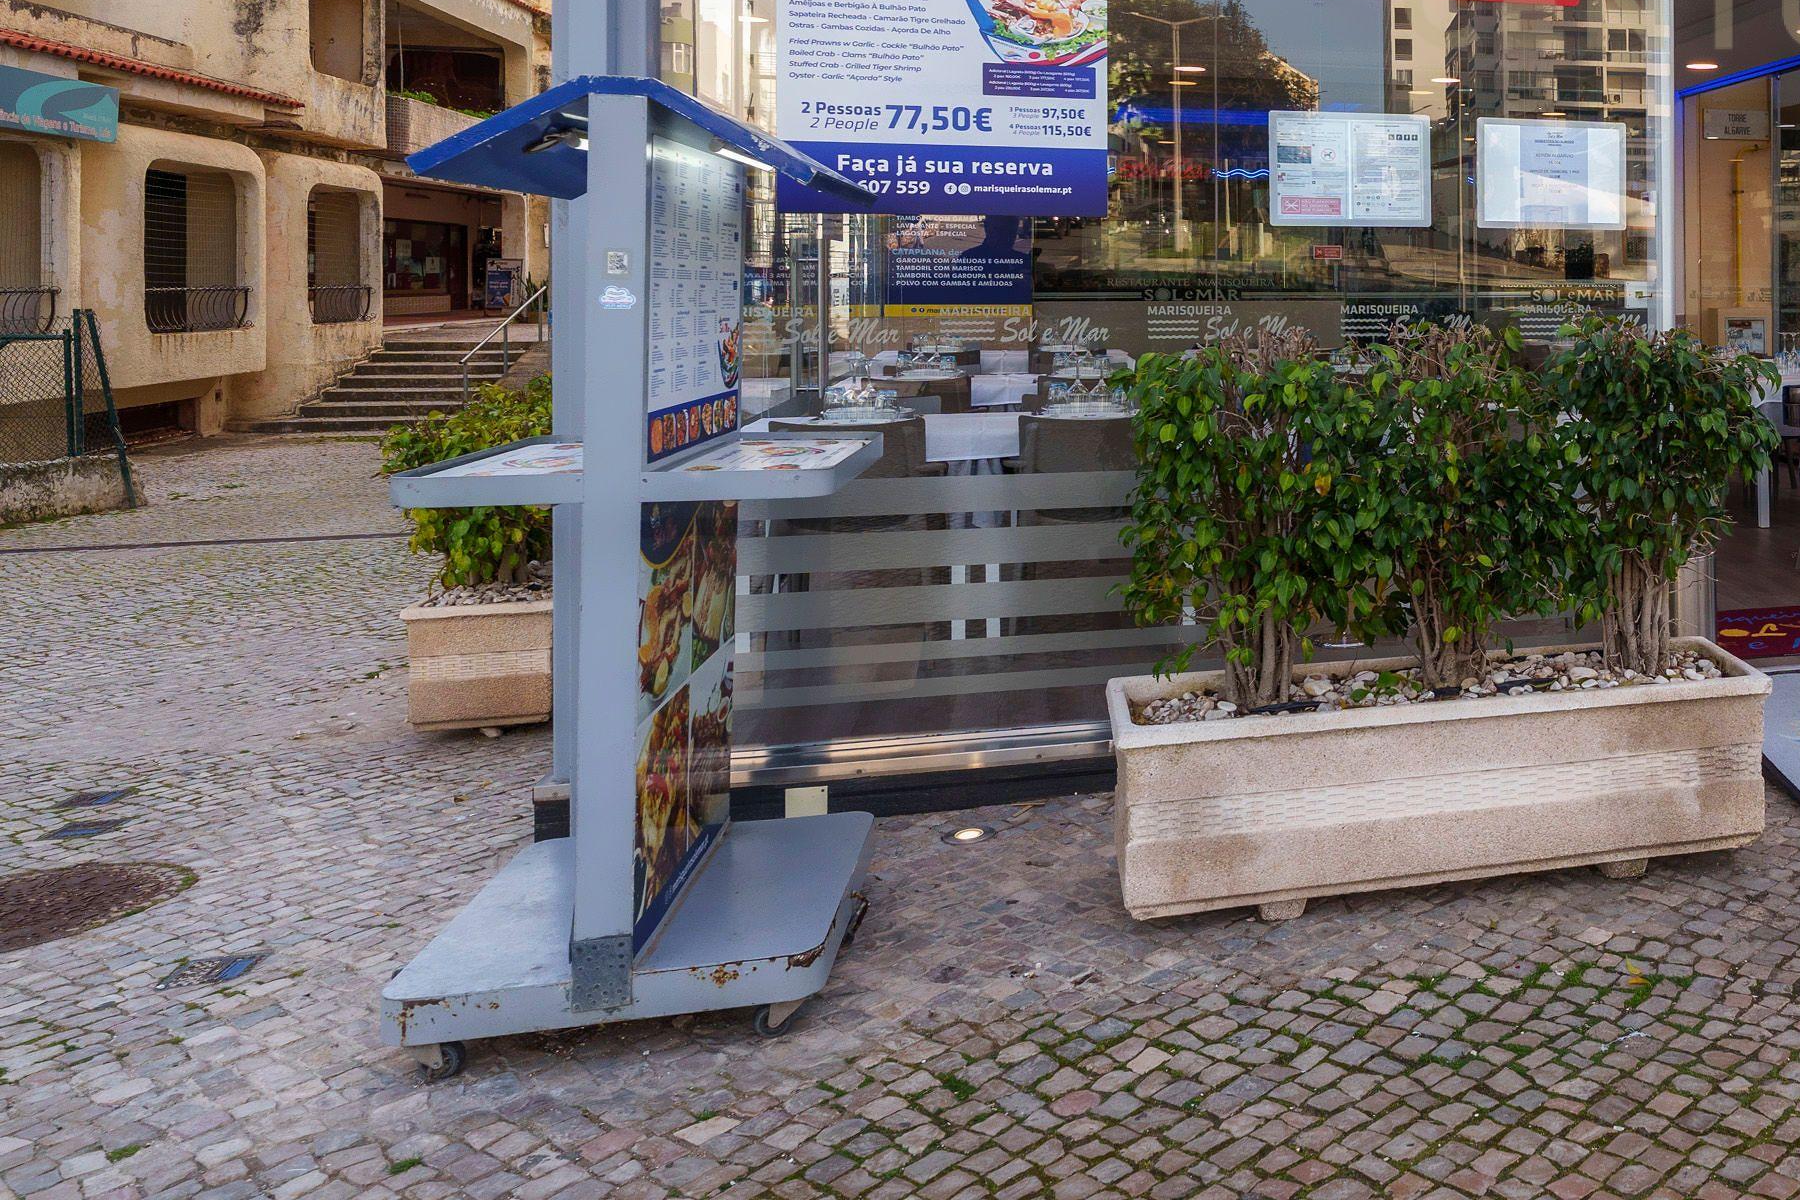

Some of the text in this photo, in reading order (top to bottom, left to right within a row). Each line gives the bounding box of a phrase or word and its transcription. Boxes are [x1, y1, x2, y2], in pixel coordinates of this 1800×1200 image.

[834, 1, 870, 10] Berbigão
[879, 3, 907, 11] Bulhão
[788, 10, 966, 25] Sapateira Recheada Camarão Tigre Grelhado
[788, 21, 951, 36] Ostras Gambas Cozidas Açorda De Alho
[788, 37, 810, 45] Fried
[811, 39, 841, 47] Prawns
[852, 40, 875, 48] Garlic
[788, 49, 867, 59] Boiled Crab Clams
[788, 60, 922, 73] Stuffed Crab Grilled Tiger Shrimp
[788, 72, 815, 80] Oyster
[883, 75, 903, 83] Style
[801, 101, 881, 116] 2 Pessoas
[1015, 106, 1041, 114] Pessoas
[1041, 107, 1086, 121] 97,50€
[810, 117, 879, 132] 2 People
[885, 104, 993, 135] 77,50€
[1727, 113, 1747, 124] TORRE
[1041, 124, 1092, 138] 115,50€
[1723, 125, 1751, 136] ALGARVE
[837, 153, 1053, 177] Faça já sua reserva
[896, 180, 931, 195] 559
[974, 183, 1072, 196] marisqueirasolemar.pt
[891, 248, 945, 256] CATAPLANA
[1106, 277, 1276, 287] RESTAURANTE MARISQUEIRA
[939, 307, 1030, 319] MARISQUEIRA
[1147, 305, 1232, 317] MARISQUEIRA
[1340, 304, 1419, 316] MARISQUEIRA
[848, 318, 901, 345] Mar
[1001, 315, 1112, 343] Sol e Mar
[1203, 315, 1240, 341] Sol
